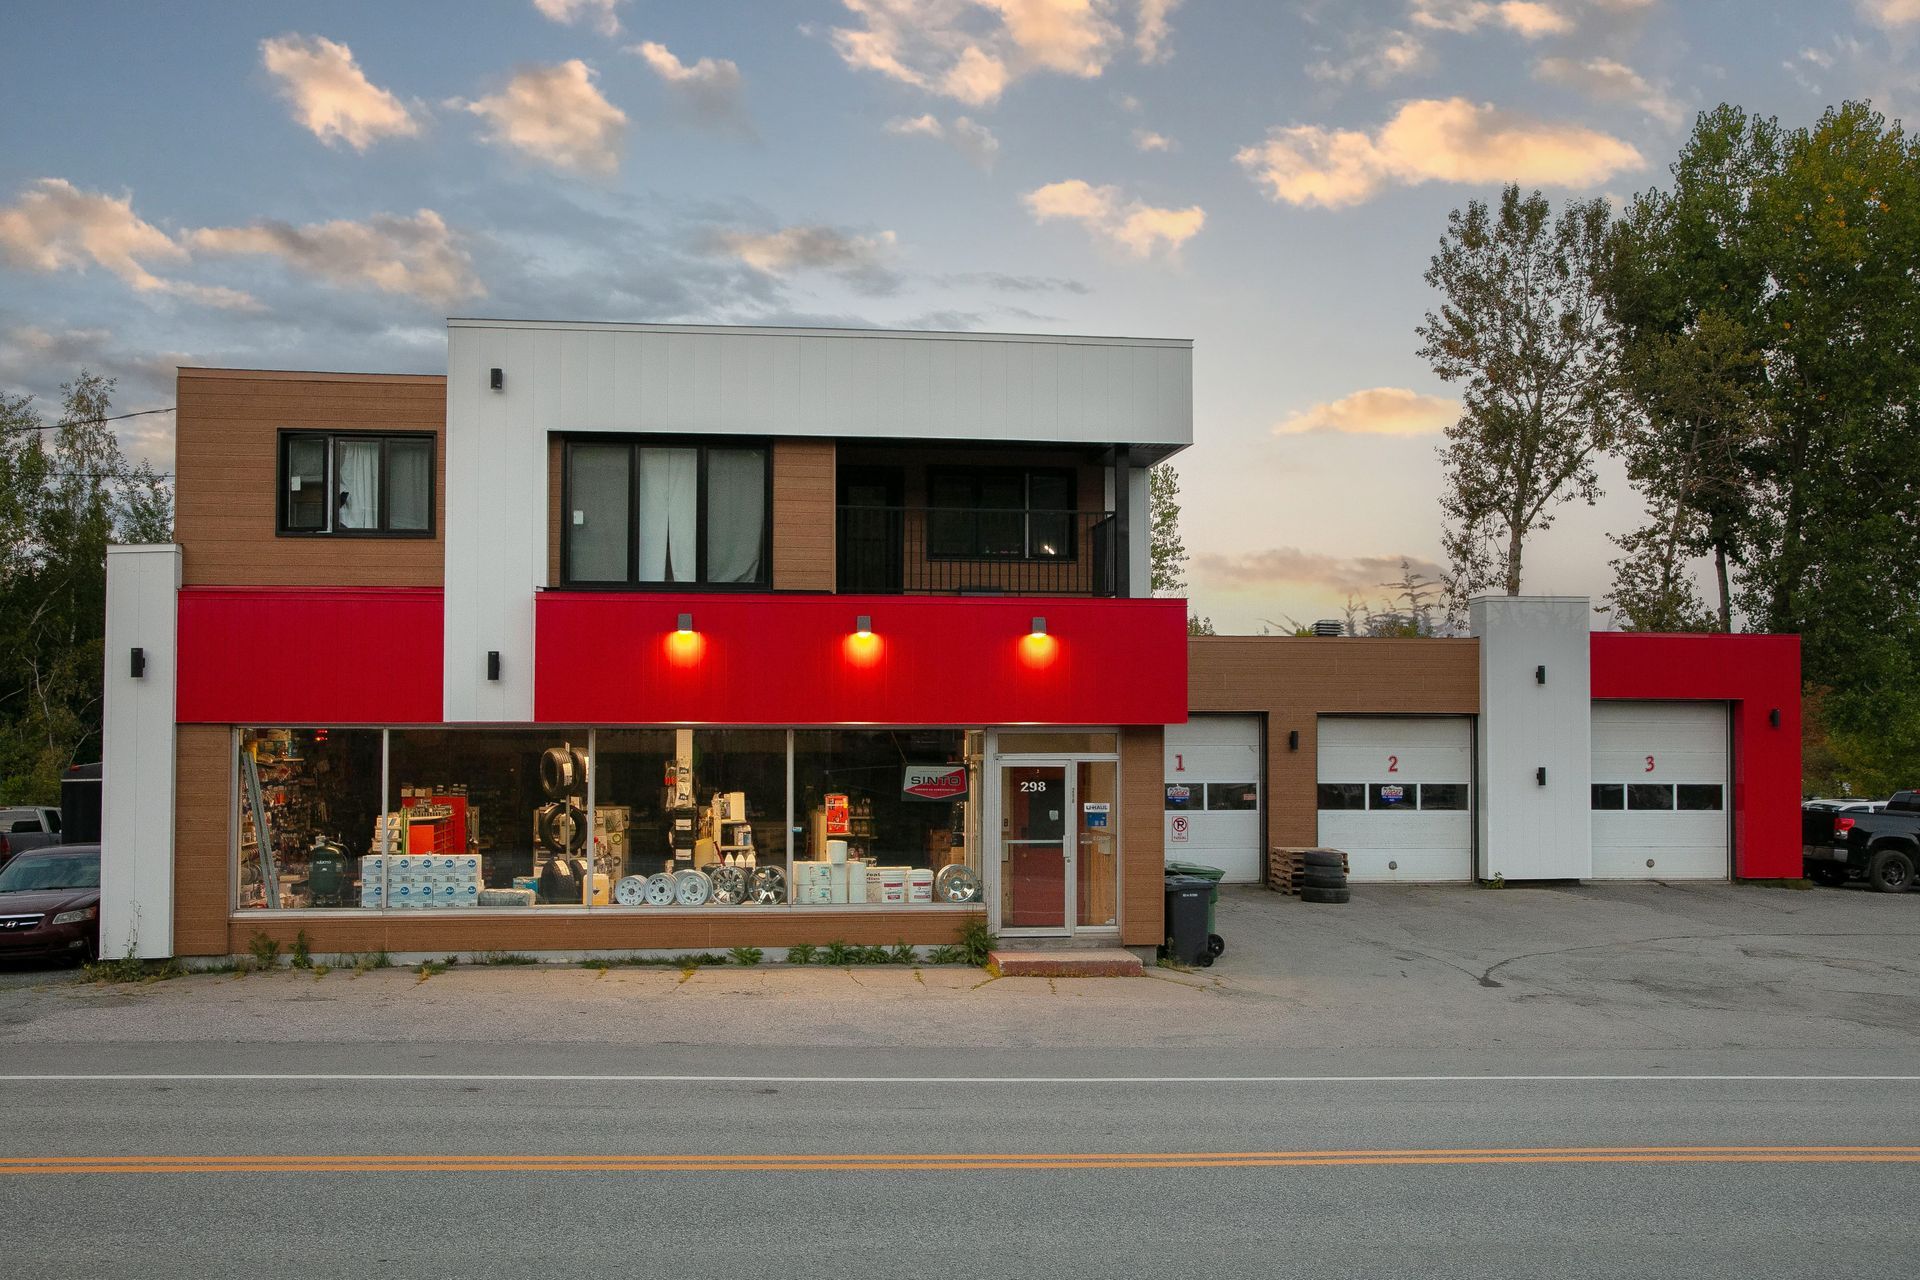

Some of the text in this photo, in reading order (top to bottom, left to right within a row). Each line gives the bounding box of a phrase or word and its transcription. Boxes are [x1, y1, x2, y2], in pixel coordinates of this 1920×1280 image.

[1175, 754, 1185, 772] 1
[1388, 755, 1398, 772] 2
[1645, 755, 1655, 772] 3
[911, 776, 960, 785] SINTO
[1020, 781, 1046, 792] 298
